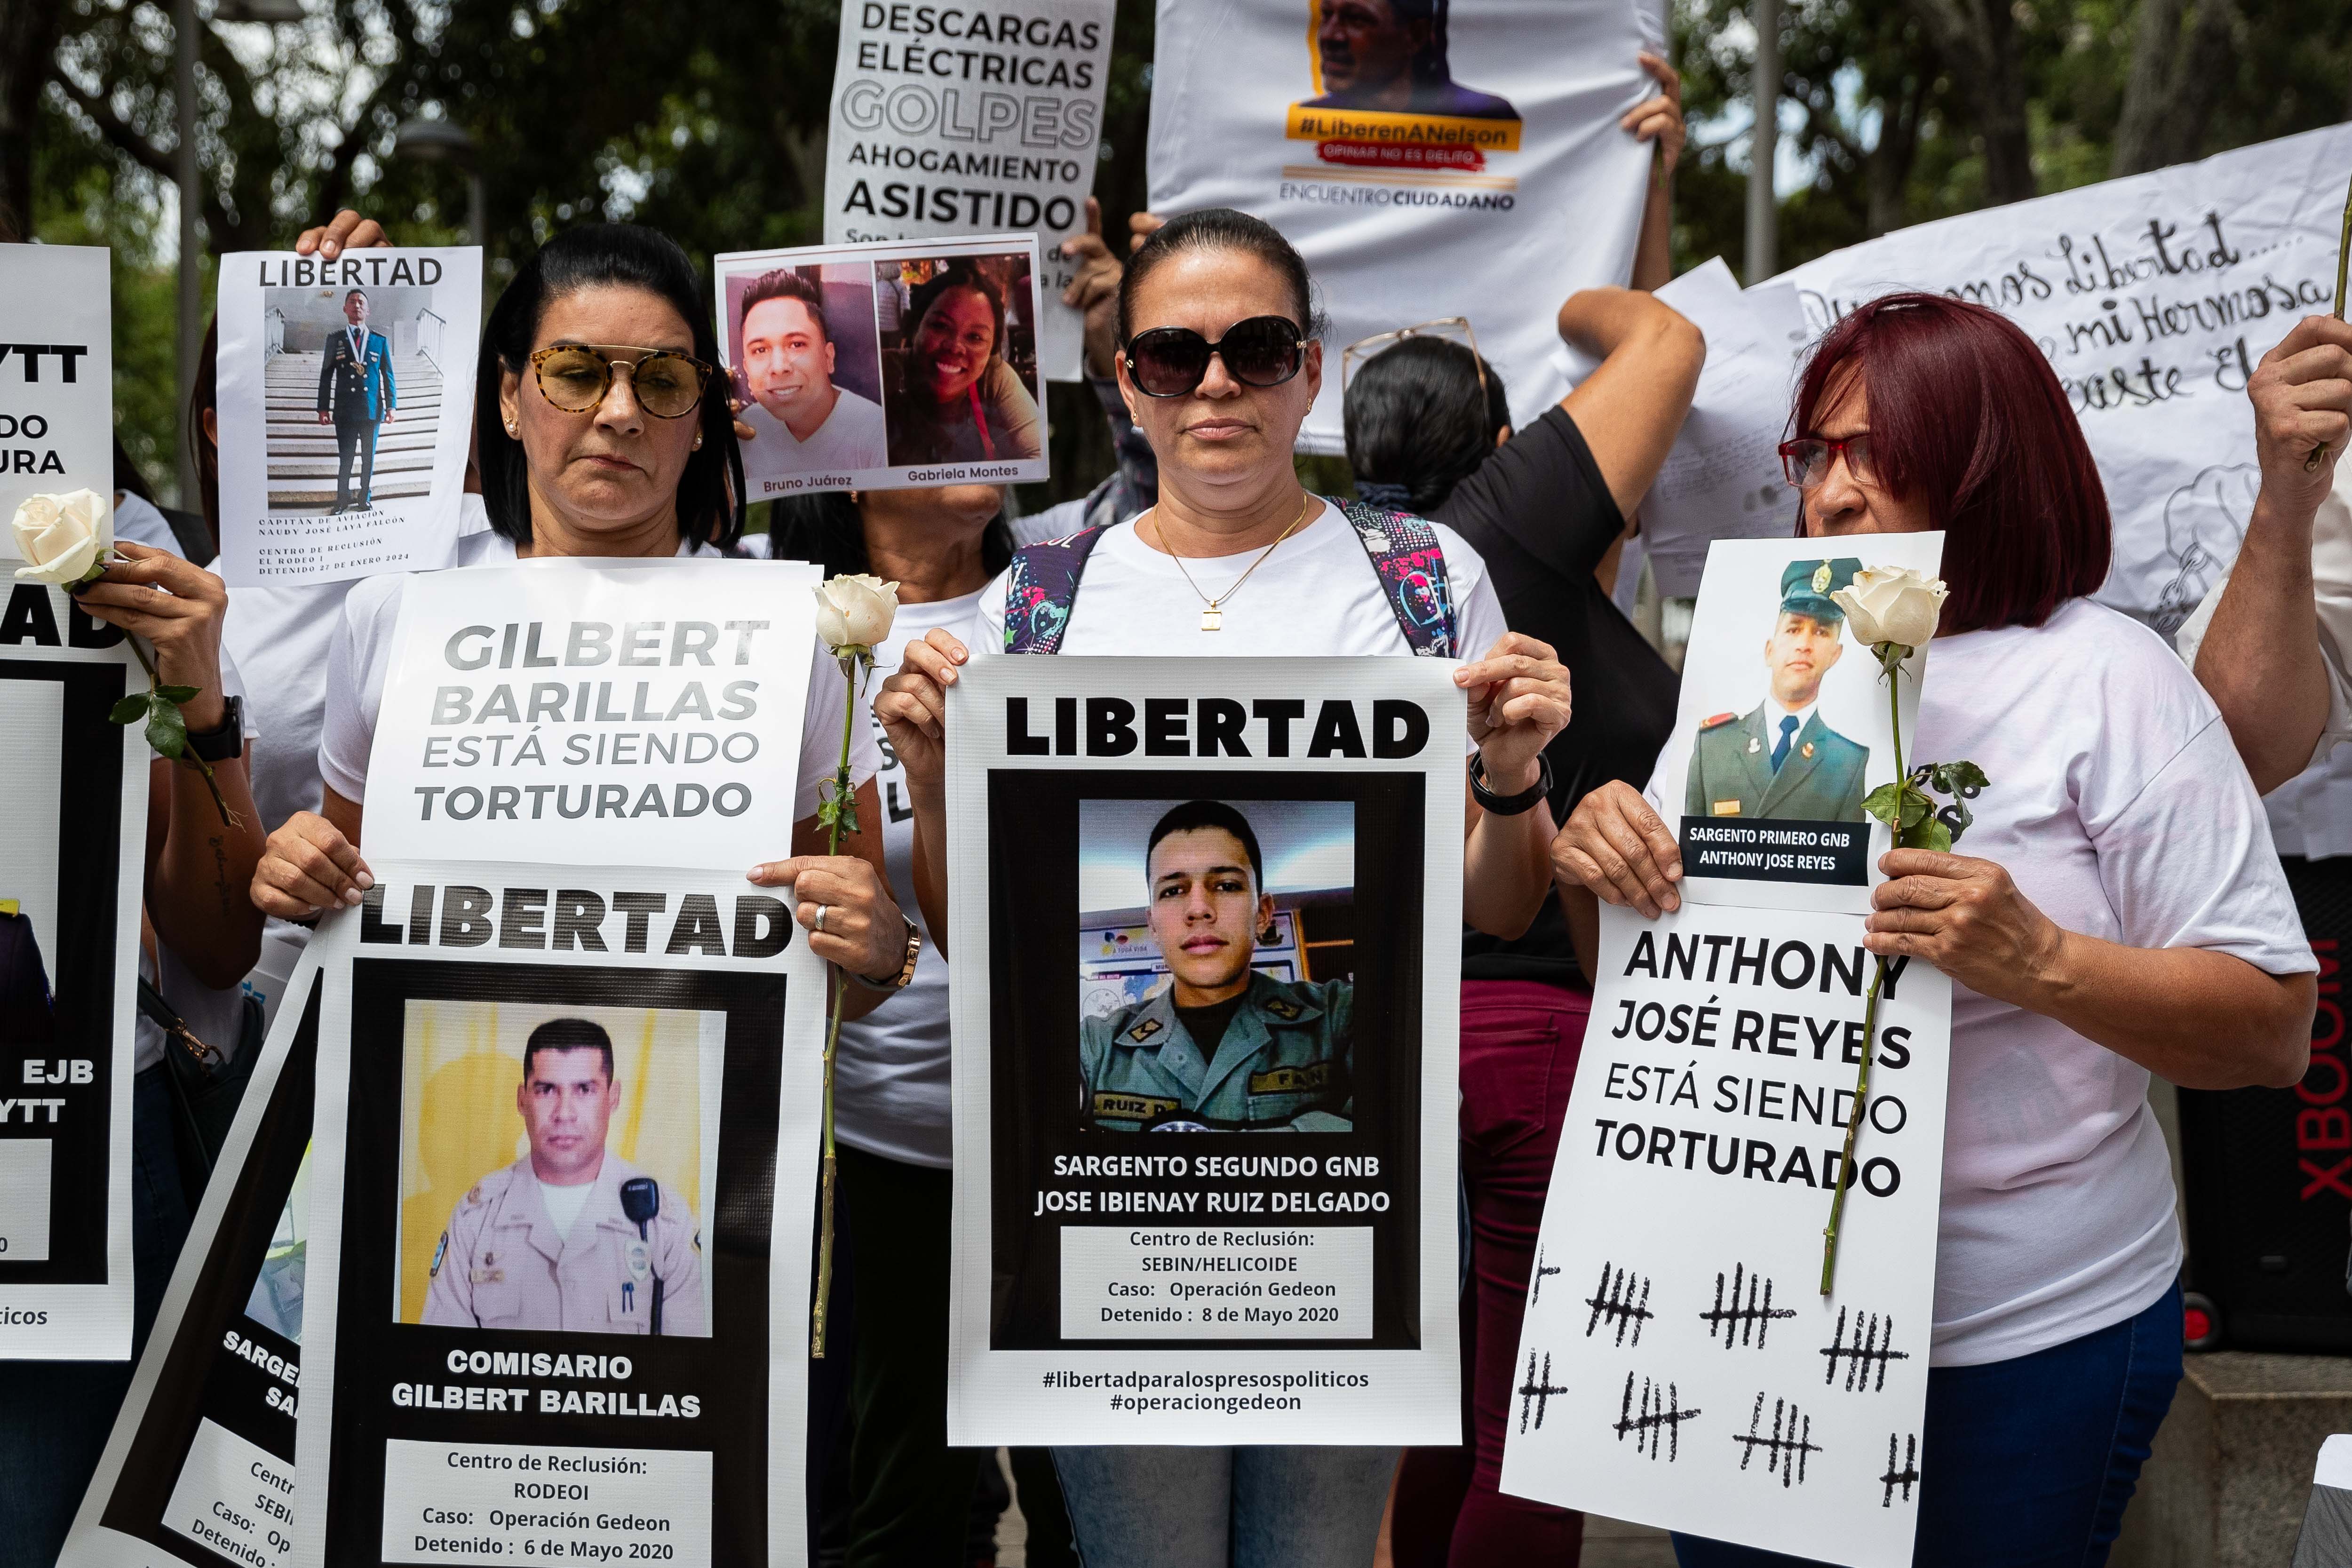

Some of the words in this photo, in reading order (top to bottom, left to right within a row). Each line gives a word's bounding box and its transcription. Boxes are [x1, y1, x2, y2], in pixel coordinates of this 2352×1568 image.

[862, 2, 1100, 50] DESCARGAS
[858, 39, 1094, 89] ELÉCTRICAS
[841, 79, 1097, 151] GOLPES
[1300, 116, 1508, 145] #LiberenANelson
[848, 142, 1080, 182] AHOGAMIENTO
[1324, 143, 1377, 159] OPINAR
[1381, 146, 1402, 160] NO
[1405, 148, 1422, 161] ES
[1425, 150, 1476, 164] DELITO
[843, 181, 1076, 231] ASISTIDO
[260, 257, 442, 287] LIBERTAD
[2130, 275, 2332, 344] Hermosa
[764, 477, 803, 493] Bruno
[807, 474, 852, 488] Juárez
[908, 469, 966, 482] Gabriela
[969, 466, 1019, 478] Montes
[259, 517, 312, 526] CAPITÁN
[336, 509, 385, 523] AVIACIÓN
[366, 516, 405, 527] FALCÓN
[327, 537, 383, 552] RECLUSIÓN
[259, 566, 315, 574] DETENIDO
[350, 557, 381, 567] ENERO
[386, 553, 409, 562] 2024
[444, 621, 770, 671] GILBERT
[430, 680, 759, 725] BARILLAS
[1006, 697, 1430, 759] LIBERTAD
[423, 725, 547, 767] ESTÁ
[563, 732, 759, 765] SIENDO
[414, 782, 752, 820] TORTURADO
[1690, 828, 1756, 844] SARGENTO
[1760, 830, 1817, 846] PRIMERO
[1820, 832, 1850, 847] GNB
[1700, 850, 1764, 867] ANTHONY
[1764, 852, 1794, 870] JOSE
[1797, 855, 1836, 870] REYES
[361, 883, 793, 958] LIBERTAD
[1623, 931, 1911, 1000] ANTHONY
[1612, 994, 1721, 1048] JOSÉ
[1732, 1009, 1912, 1070] REYES
[24, 1059, 93, 1083] EJB
[1104, 1099, 1146, 1113] RUIZ
[1604, 1060, 1699, 1110] ESTÁ
[1713, 1075, 1907, 1134] SIENDO
[1054, 1156, 1187, 1177] SARGENTO
[1195, 1156, 1318, 1177] SEGUNDO
[1326, 1157, 1379, 1177] GNB
[1595, 1119, 1901, 1198] TORTURADO
[1035, 1191, 1091, 1216] JOSE
[1100, 1192, 1200, 1212] IBIENAY
[1207, 1193, 1263, 1212] RUIZ
[1272, 1192, 1390, 1212] DELGADO
[1130, 1231, 1190, 1246] Centro
[1196, 1230, 1217, 1246] de
[1224, 1231, 1314, 1247] Reclusión:
[1142, 1257, 1297, 1273] SEBIN/HELICOIDE
[1108, 1282, 1155, 1297] Caso:
[1170, 1281, 1262, 1300] Operación
[1268, 1281, 1336, 1297] Gedeon
[1101, 1307, 1182, 1323] Detenido
[1202, 1307, 1212, 1322] 8
[1217, 1307, 1239, 1323] de
[1245, 1308, 1293, 1326] Mayo
[1298, 1307, 1339, 1322] 2020
[223, 1331, 300, 1388] SARGE
[447, 1350, 632, 1379] COMISARIO
[1042, 1371, 1369, 1392] #libertadparalospresospoliticos
[393, 1383, 528, 1411] GILBERT
[540, 1390, 700, 1417] BARILLAS
[1110, 1394, 1301, 1414] #operaciongedeon
[448, 1452, 512, 1470] Centro
[518, 1453, 541, 1471] de
[548, 1455, 647, 1474] Reclusión:
[514, 1483, 589, 1500] RODEOI
[213, 1501, 255, 1534] Caso:
[255, 1494, 294, 1526] SEBI
[423, 1508, 473, 1525] Caso:
[490, 1510, 589, 1530] Operación
[596, 1513, 670, 1531] Gedeon
[192, 1519, 266, 1568] Detenido
[415, 1535, 503, 1554] Detenido
[524, 1539, 535, 1554] 6
[541, 1540, 564, 1556] de
[571, 1541, 623, 1561] Mayo
[629, 1543, 674, 1560] 2020
